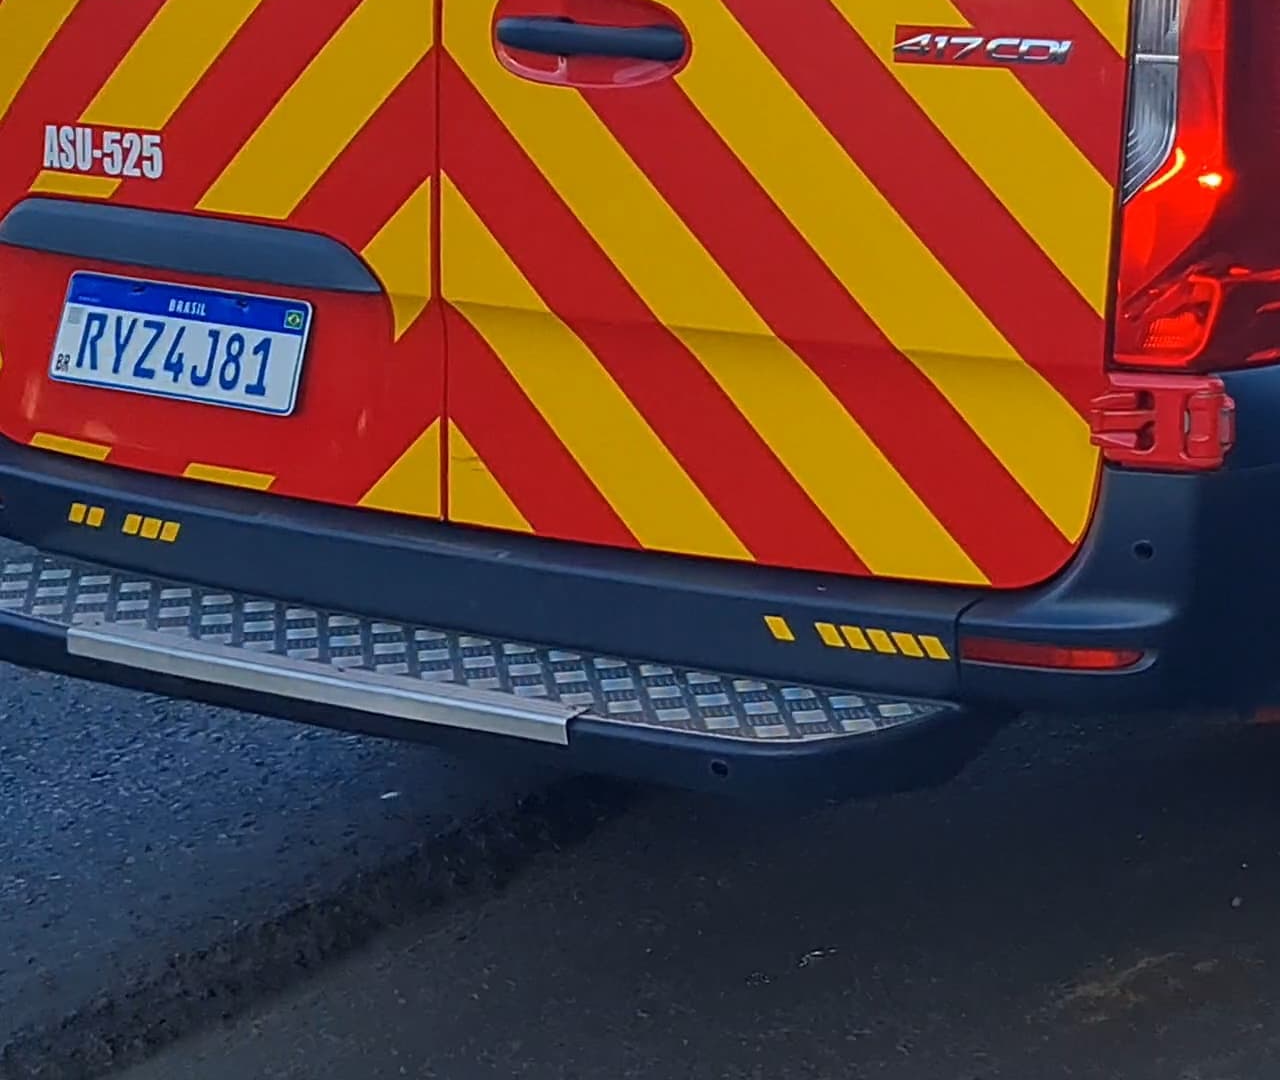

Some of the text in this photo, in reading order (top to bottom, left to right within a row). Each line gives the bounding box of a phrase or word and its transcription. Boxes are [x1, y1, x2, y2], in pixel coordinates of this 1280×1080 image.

[43, 125, 163, 179] ASU-525
[167, 297, 208, 317] BRASIL
[55, 353, 71, 373] BR
[75, 311, 273, 397] RYZ4J81
